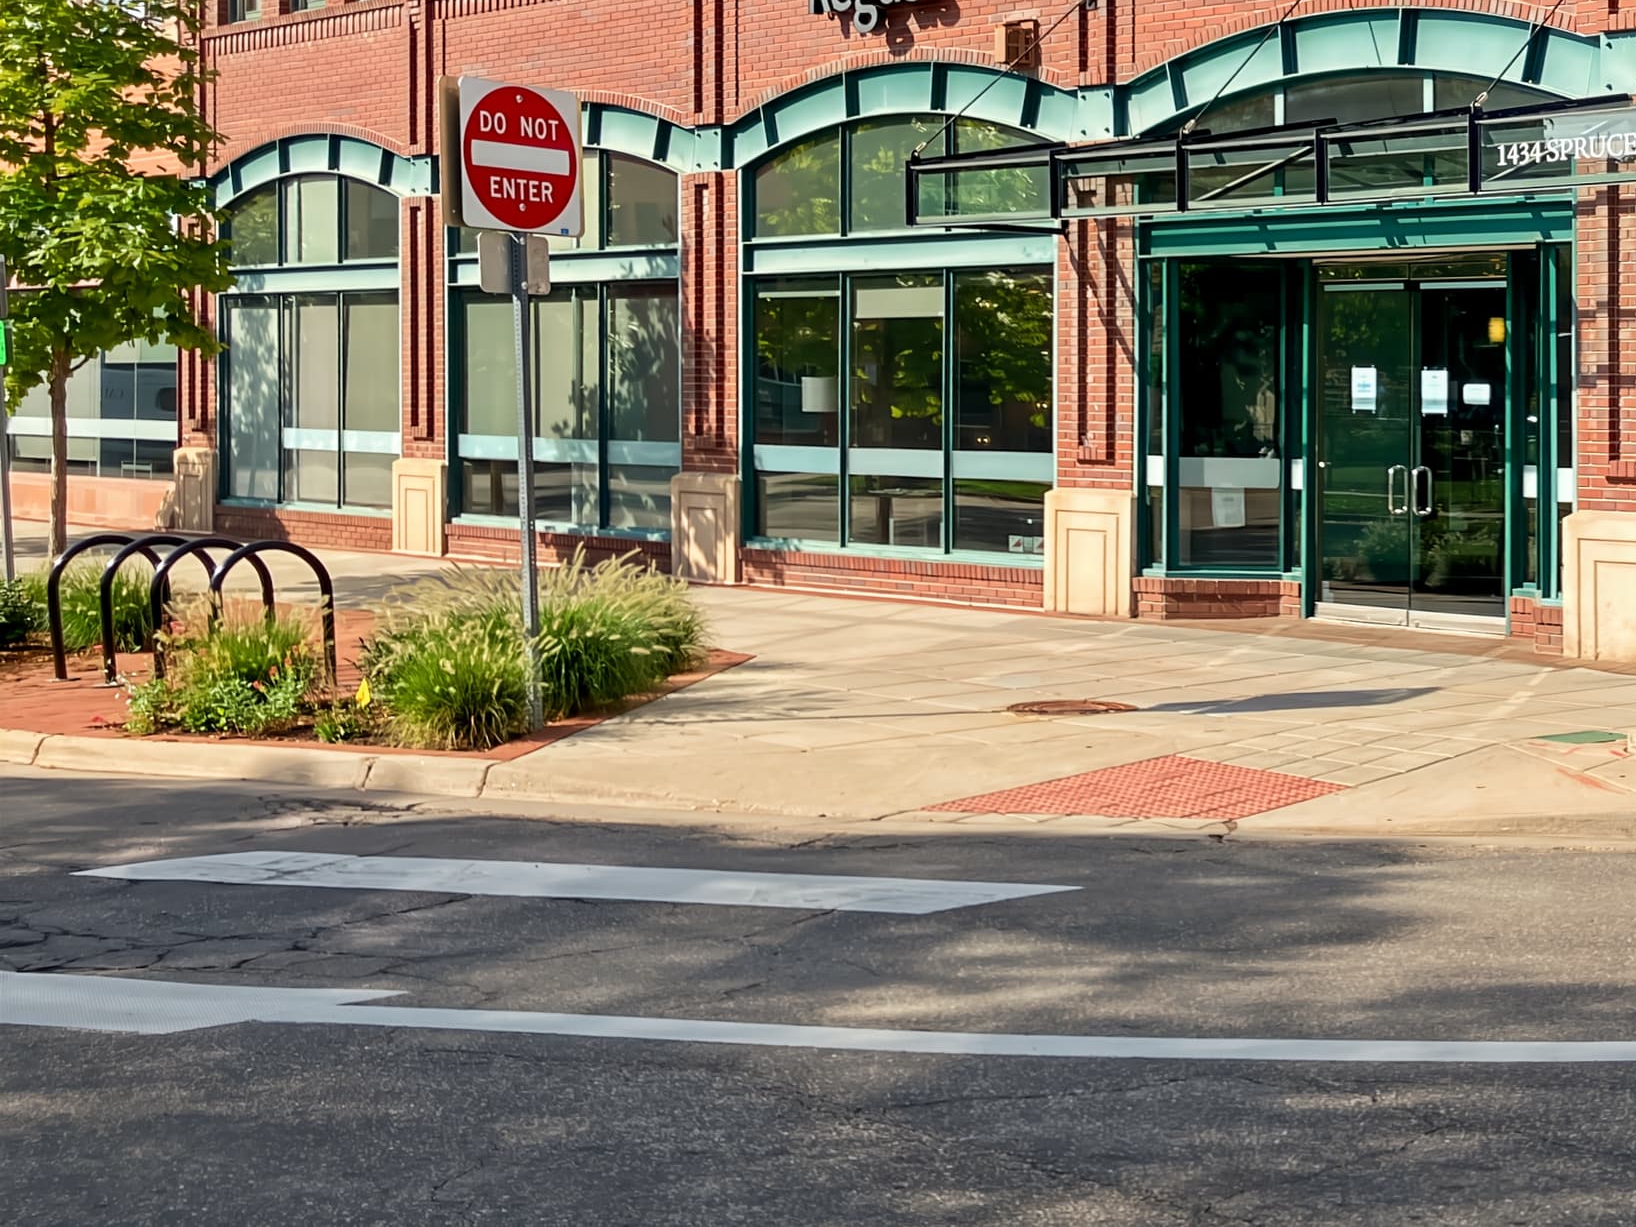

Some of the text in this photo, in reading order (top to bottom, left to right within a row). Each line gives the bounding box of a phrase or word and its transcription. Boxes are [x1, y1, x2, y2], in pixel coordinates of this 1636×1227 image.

[478, 110, 560, 142] DO NOT
[1496, 141, 1543, 167] 1434
[489, 175, 554, 204] ENTER
